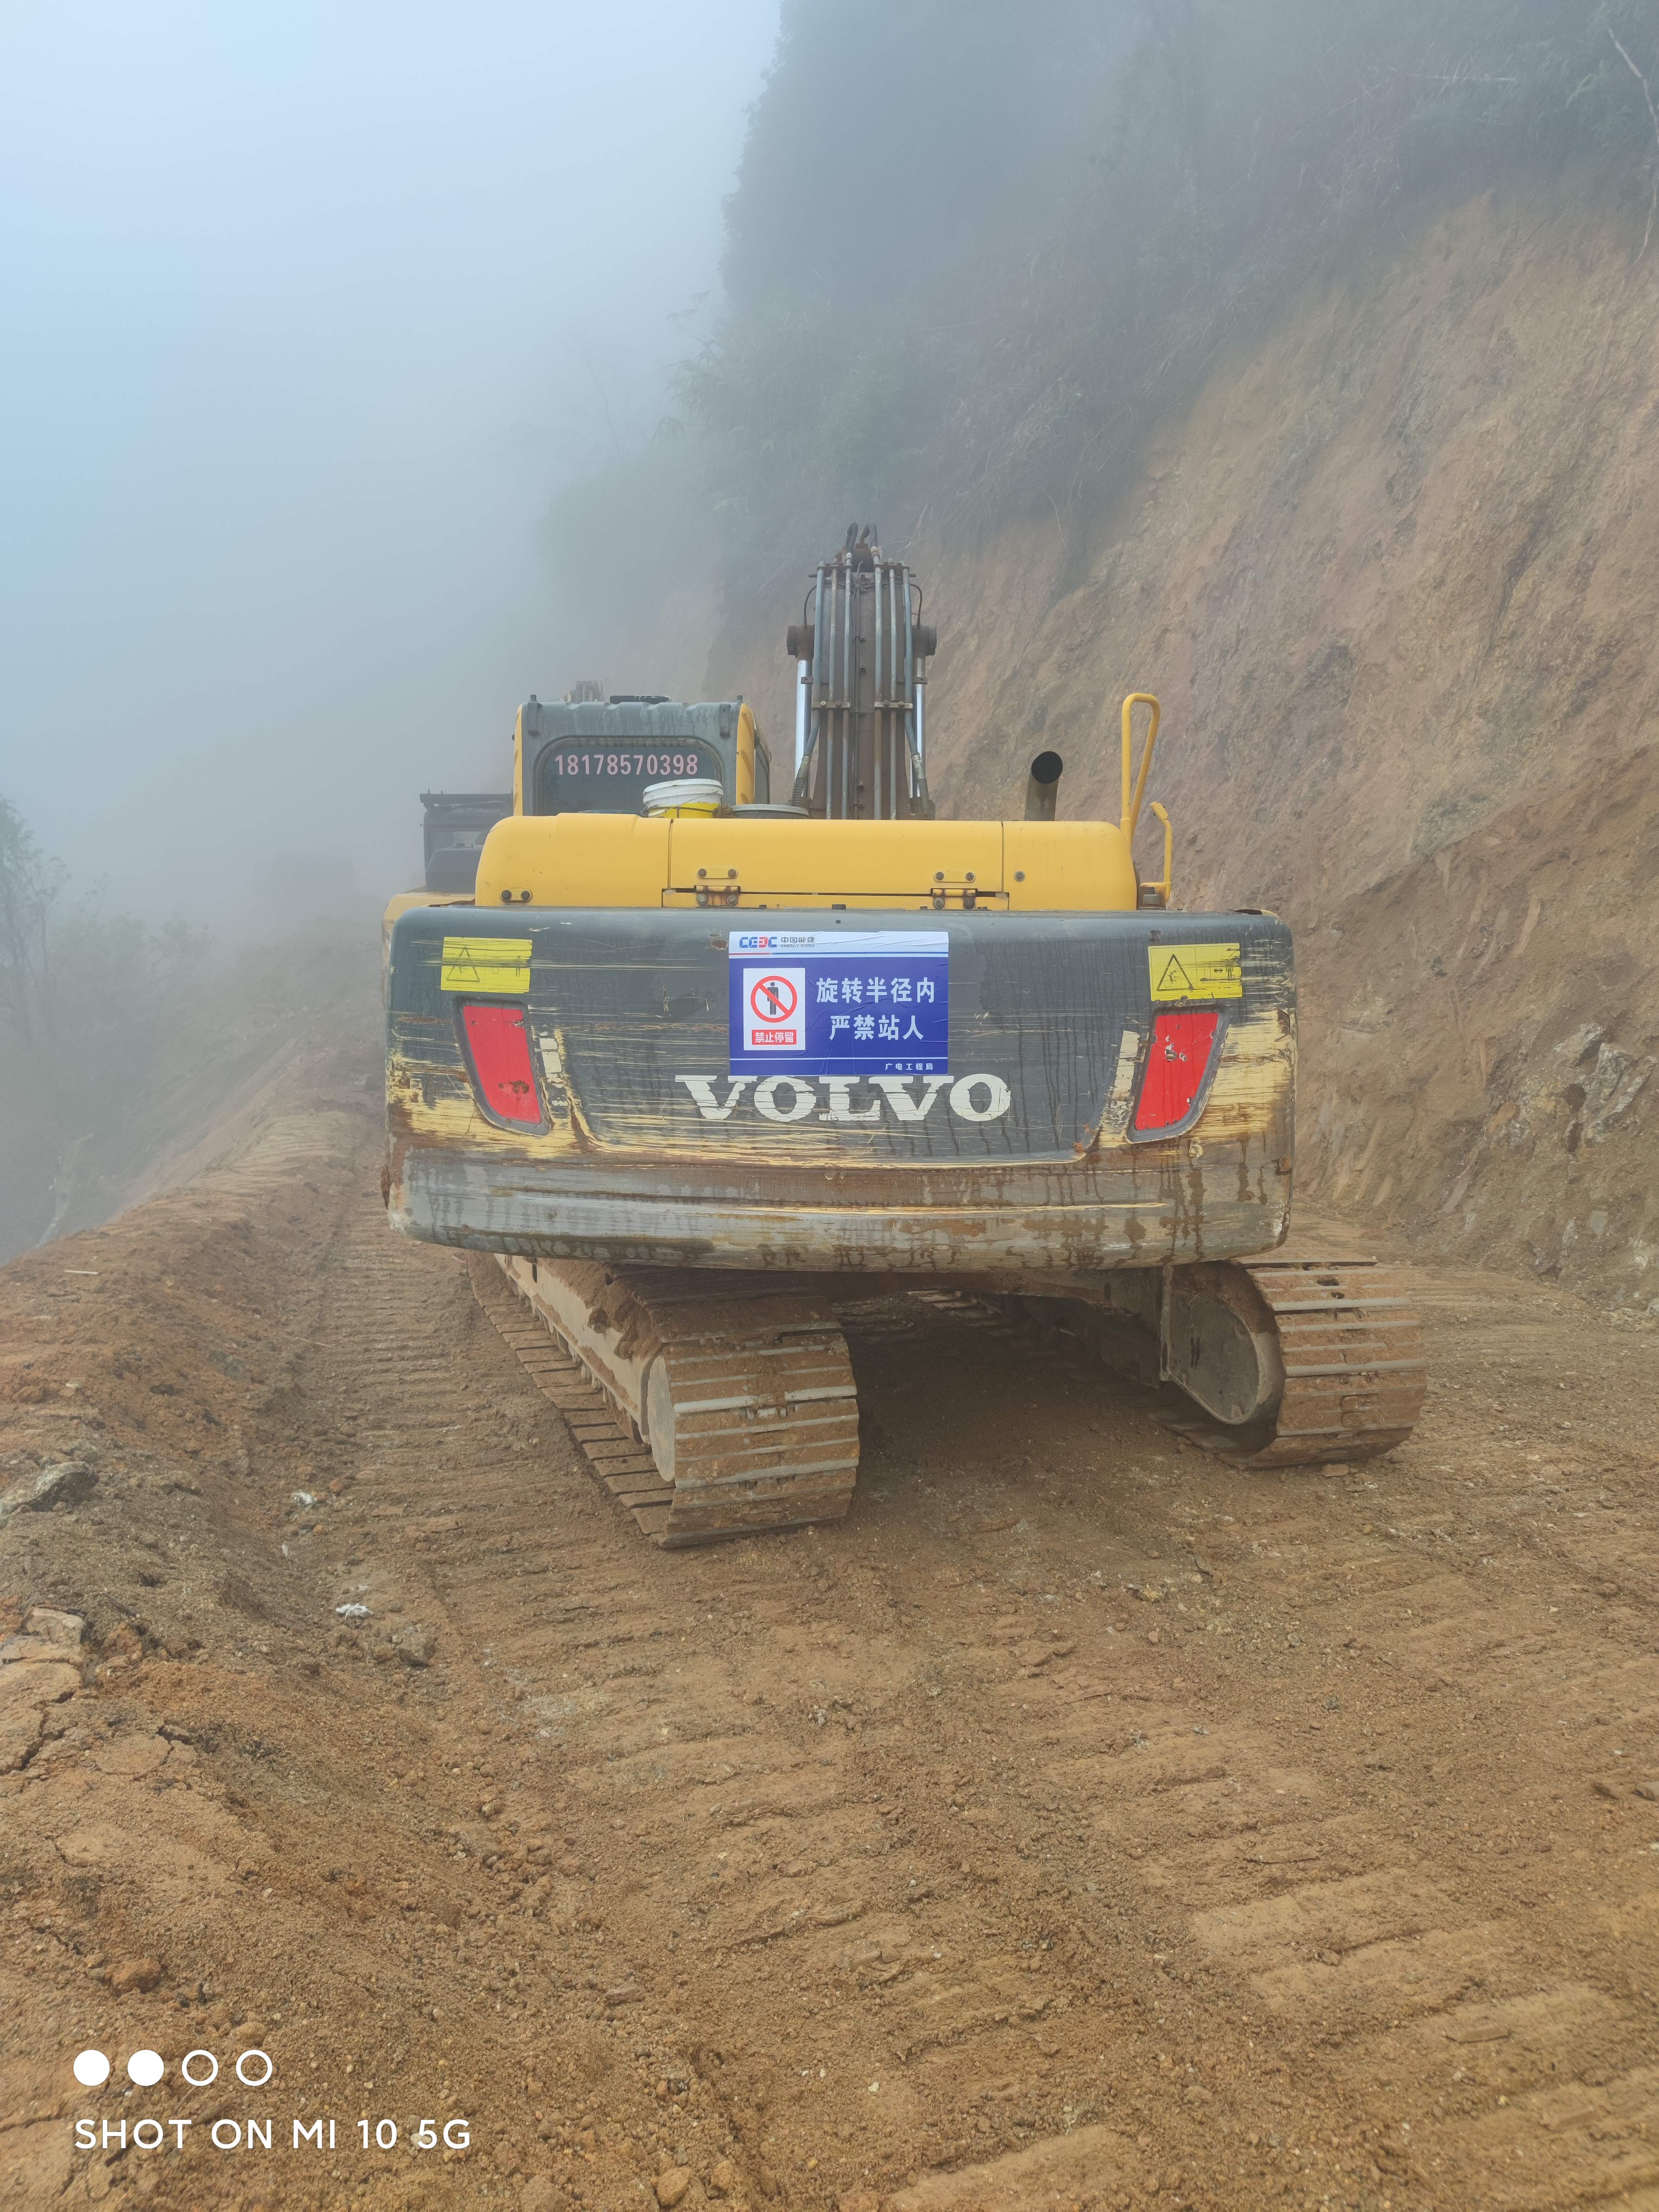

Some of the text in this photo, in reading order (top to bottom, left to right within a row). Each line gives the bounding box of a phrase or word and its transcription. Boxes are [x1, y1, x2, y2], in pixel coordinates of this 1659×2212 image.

[555, 754, 698, 776] 18178570398
[816, 977, 935, 1004] 旋转半径内
[754, 1032, 794, 1043] 禁止停留
[829, 1014, 924, 1041] 严禁站人
[885, 1063, 933, 1071] 广电工程局
[674, 1073, 1012, 1122] VOLVO
